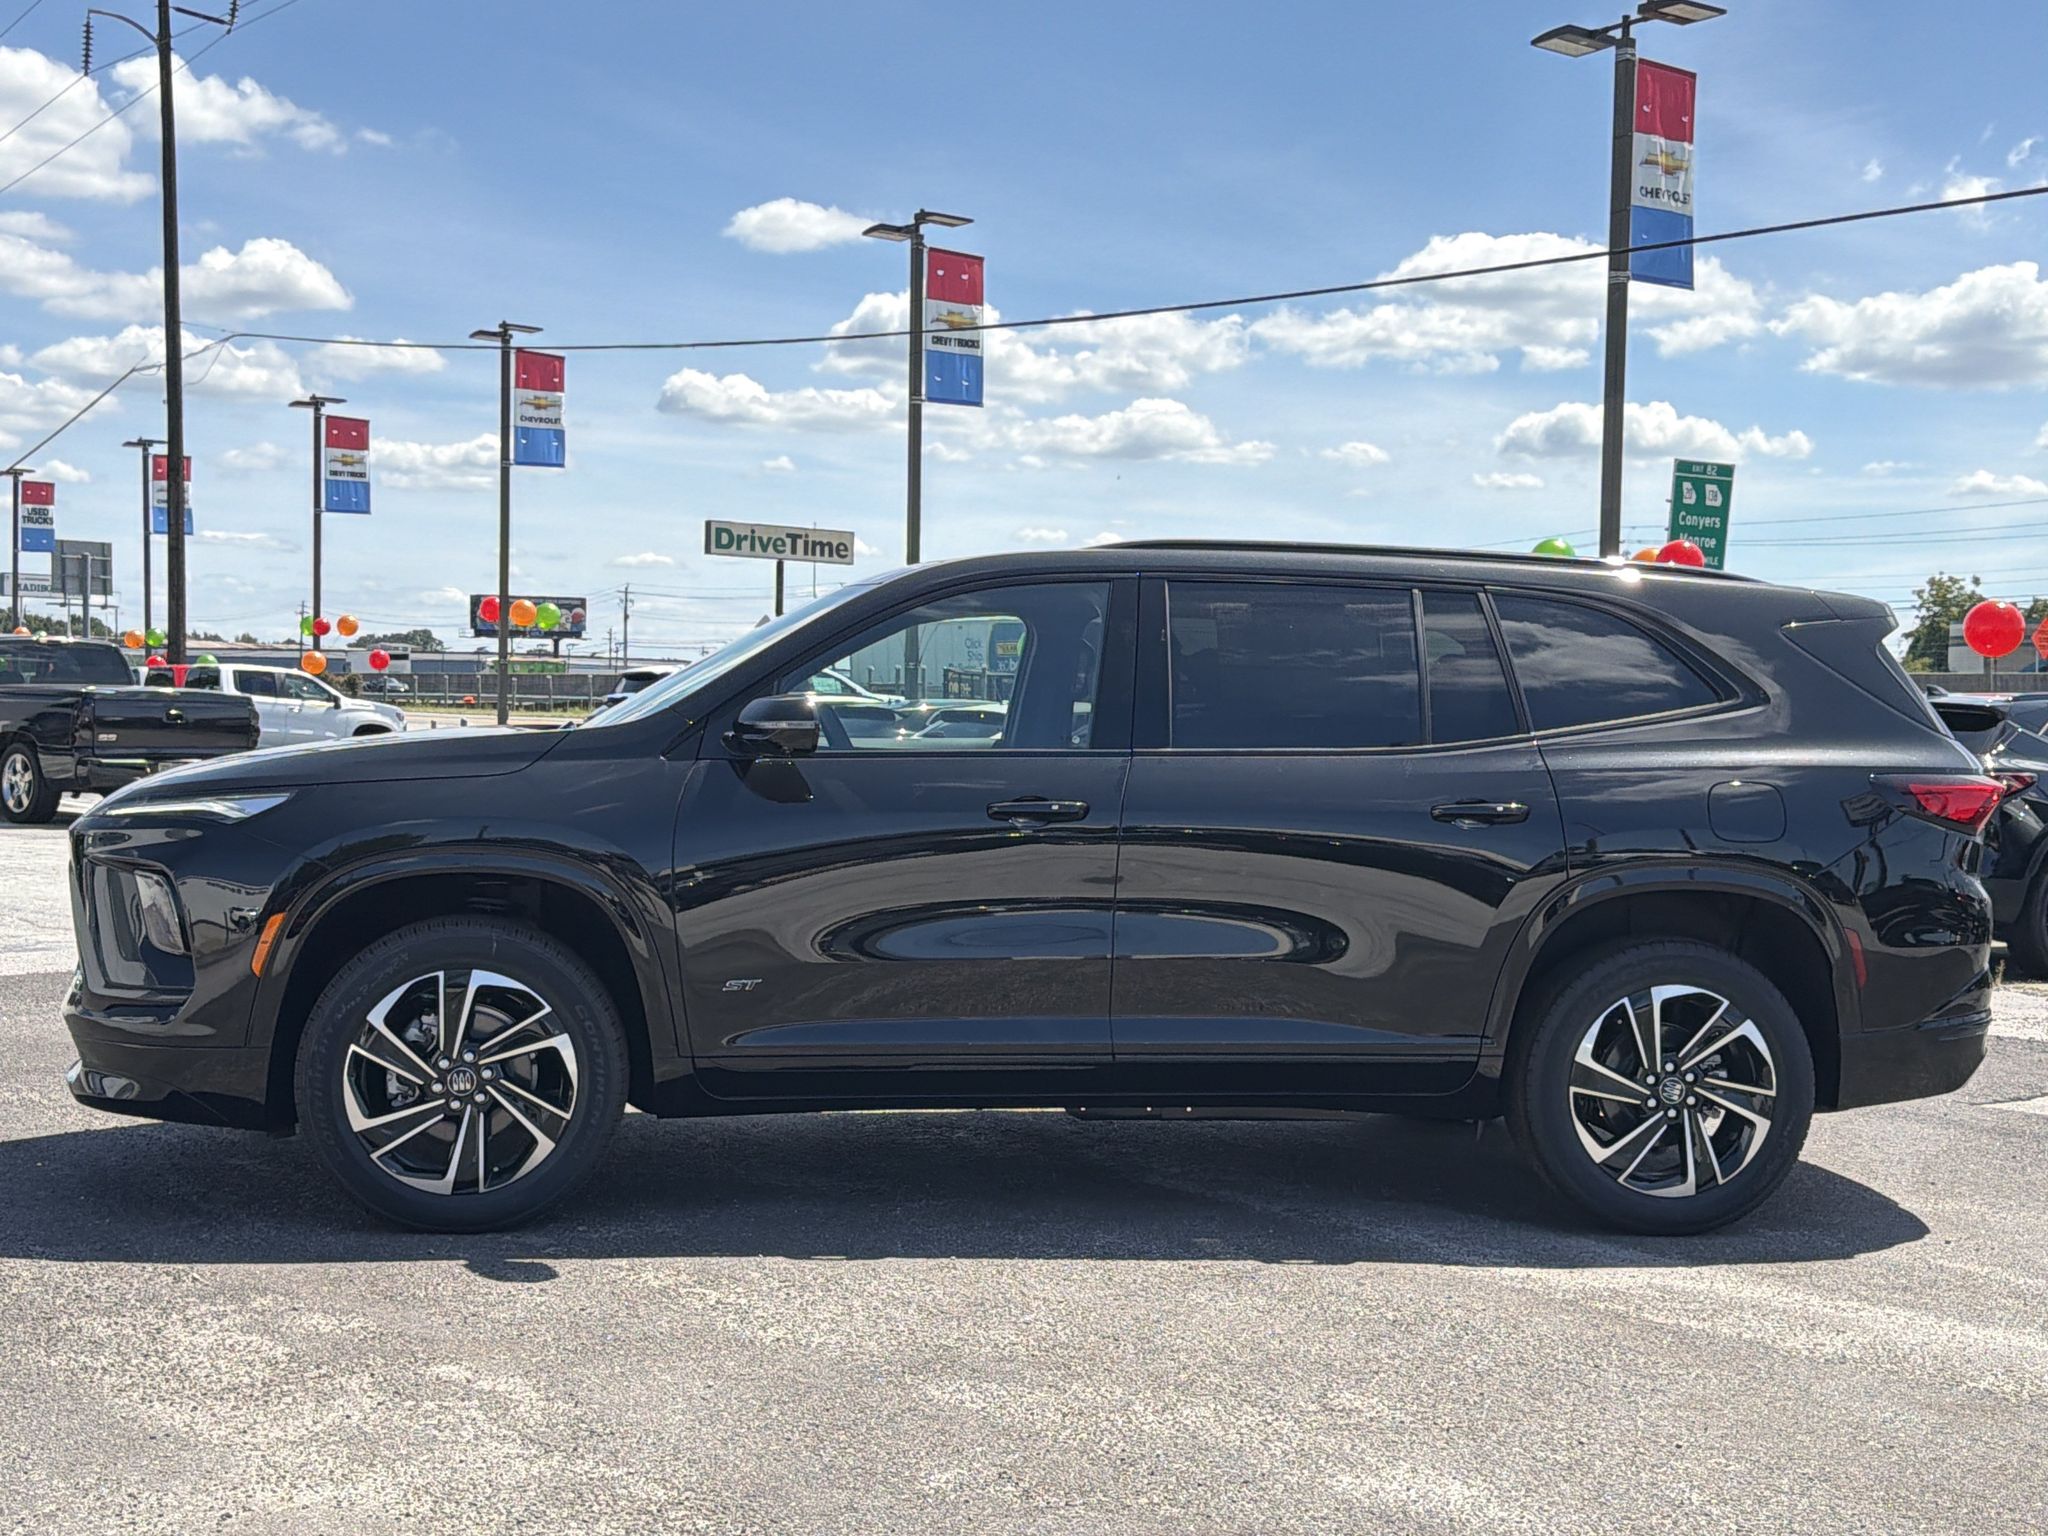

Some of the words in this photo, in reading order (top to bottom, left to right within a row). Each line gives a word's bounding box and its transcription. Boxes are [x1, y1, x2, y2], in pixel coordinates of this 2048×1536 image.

[931, 335, 952, 346] CHEVY
[954, 337, 980, 349] TRUCKS
[1706, 465, 1718, 476] 82
[26, 507, 49, 517] USED
[22, 515, 54, 525] TRUCKS
[1679, 511, 1720, 529] Conyers
[714, 527, 849, 559] DriveTime
[722, 979, 763, 992] ST
